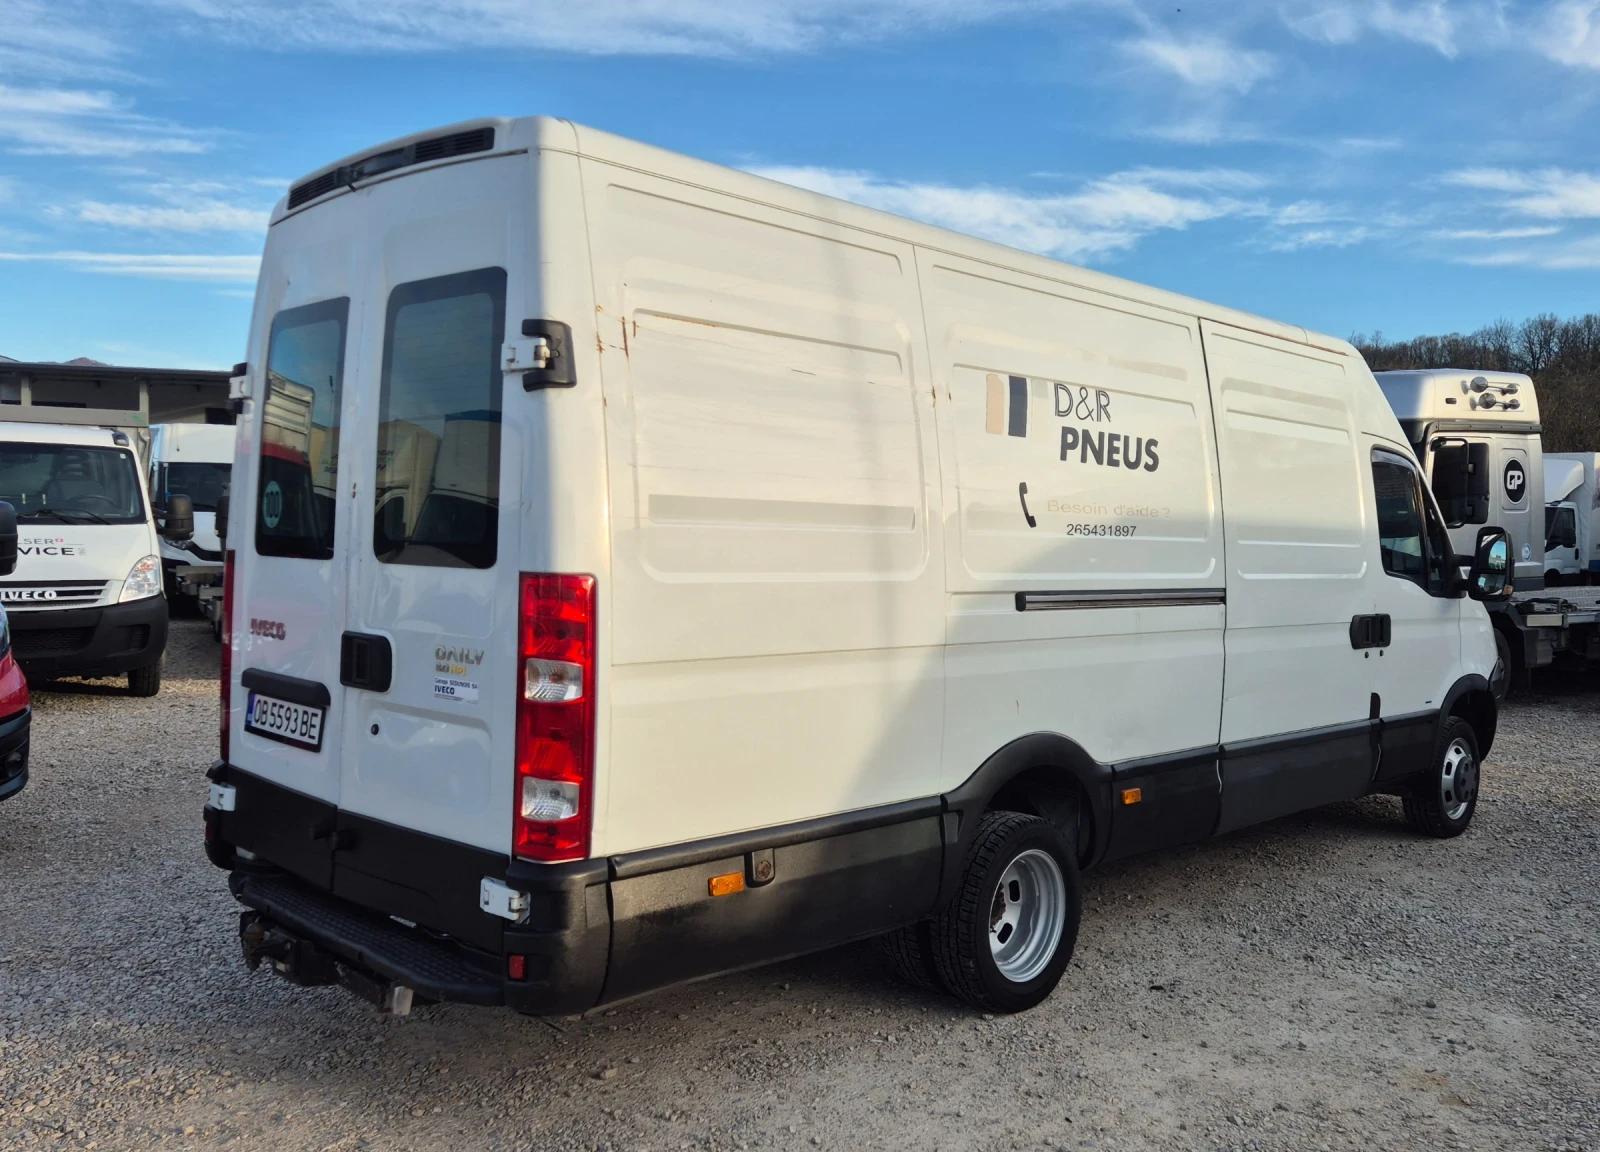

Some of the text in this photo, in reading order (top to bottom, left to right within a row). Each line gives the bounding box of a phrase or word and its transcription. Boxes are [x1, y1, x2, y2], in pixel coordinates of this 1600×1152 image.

[1053, 382, 1112, 423] D&R
[1059, 425, 1160, 473] PNEUS
[1047, 500, 1108, 515] Besoin
[1066, 524, 1137, 537] 265431897
[0, 590, 58, 601] IVECO
[250, 618, 286, 641] IVECO
[435, 644, 485, 666] DAILY
[434, 684, 455, 695] IVECO
